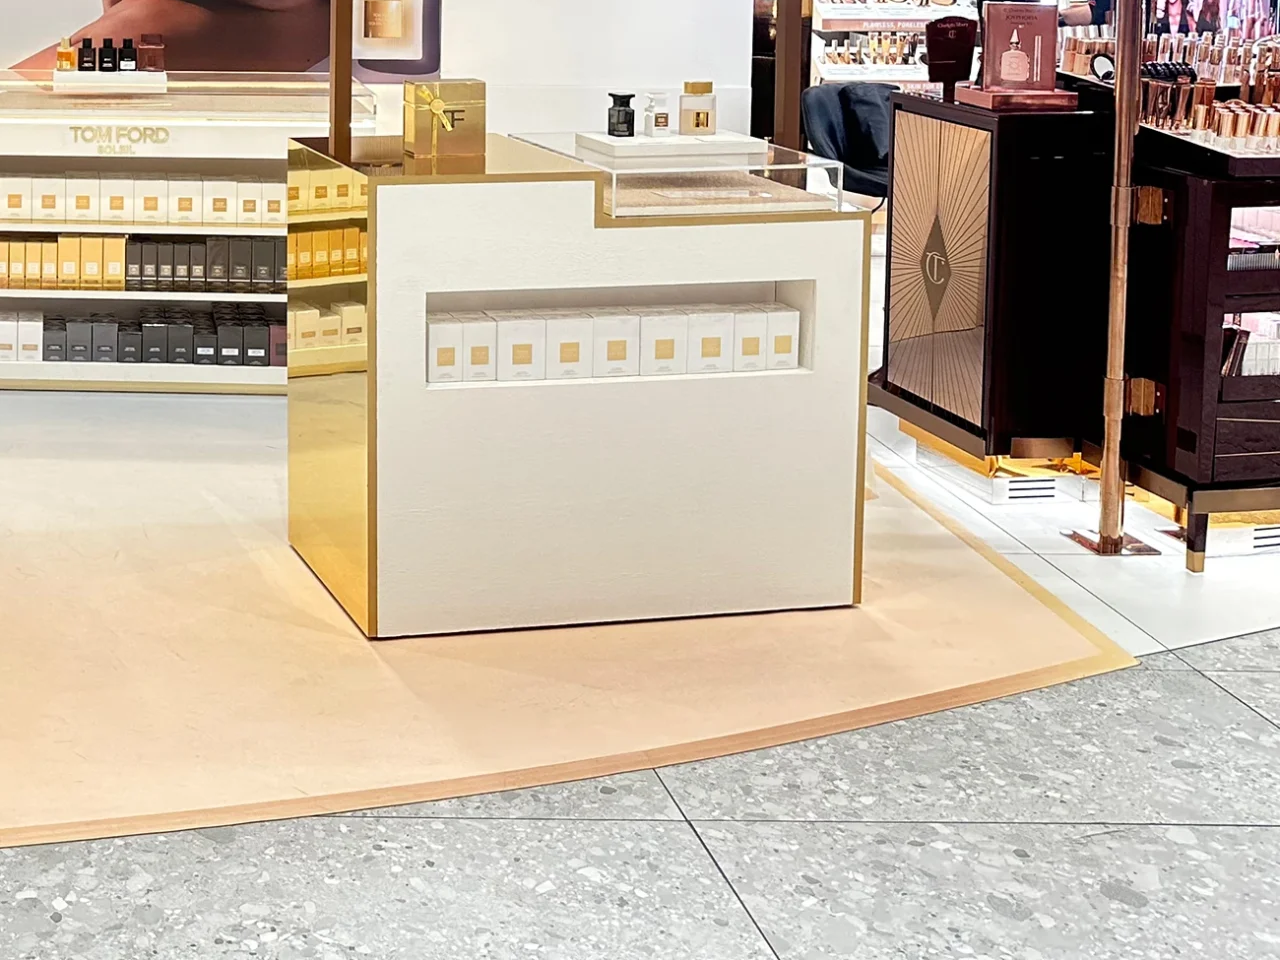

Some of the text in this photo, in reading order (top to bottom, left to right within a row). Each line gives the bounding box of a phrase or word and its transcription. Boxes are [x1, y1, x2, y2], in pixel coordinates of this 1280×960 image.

[69, 126, 170, 144] TOM FORD
[97, 145, 136, 155] SOLEIL
